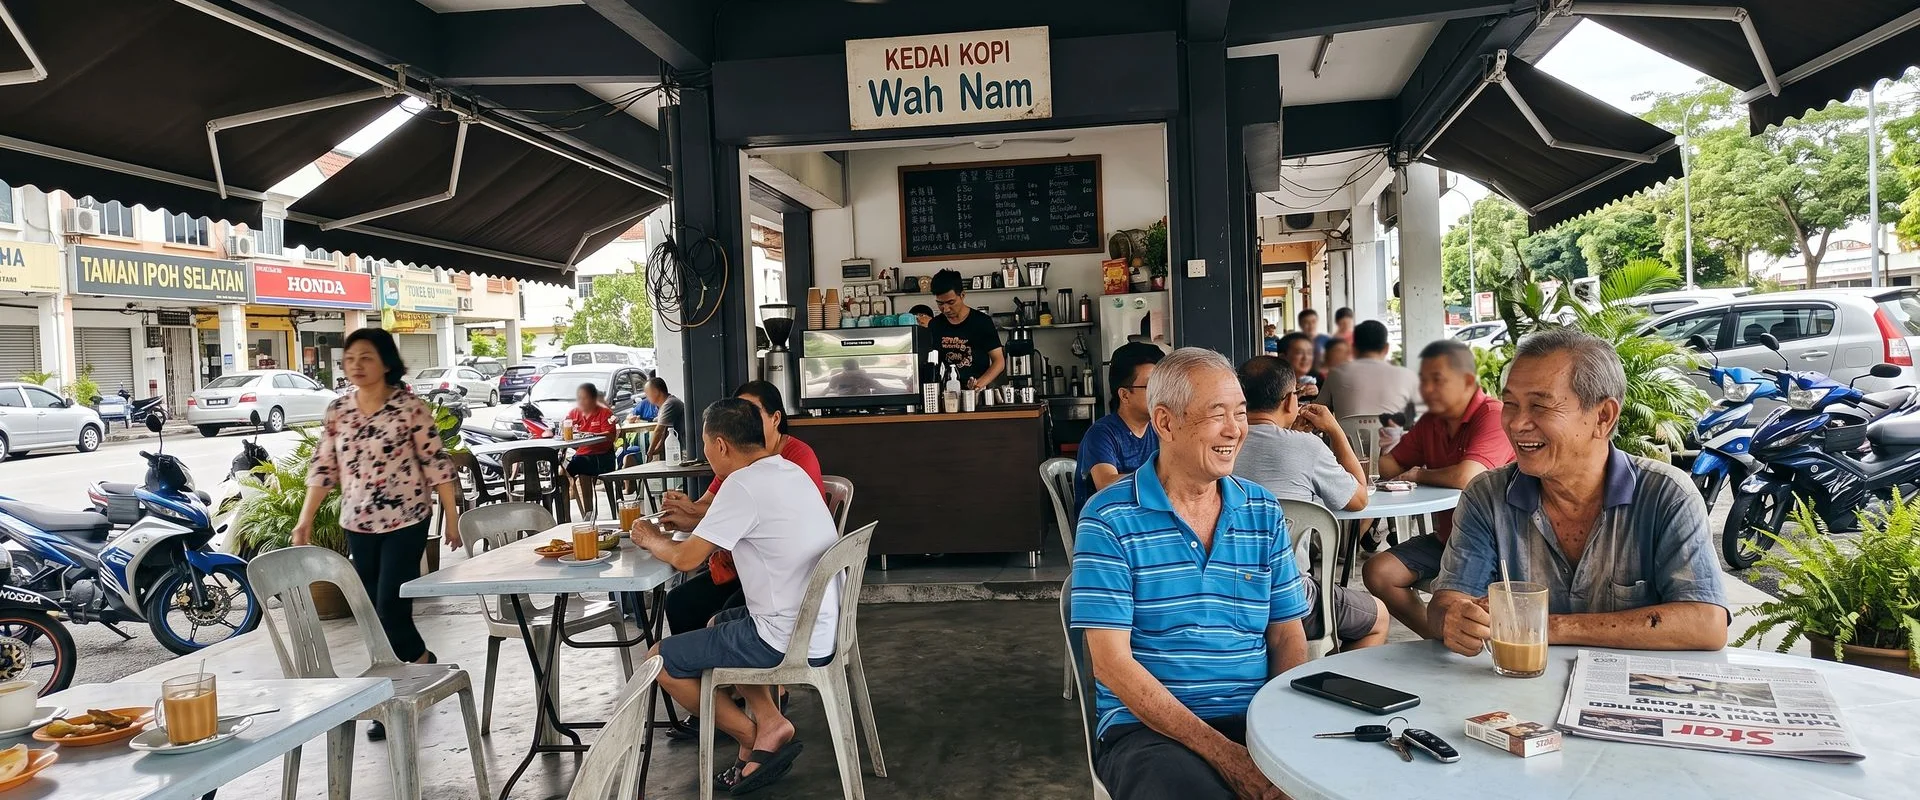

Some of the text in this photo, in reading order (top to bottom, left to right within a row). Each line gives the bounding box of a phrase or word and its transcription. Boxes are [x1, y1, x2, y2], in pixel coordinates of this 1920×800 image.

[885, 40, 1010, 71] KEDAI KOPI
[868, 71, 1032, 117] Wah Nam
[80, 256, 245, 293] TAMAN IPOH SELATAN
[287, 276, 346, 295] HONDA
[1671, 724, 1775, 746] Star
